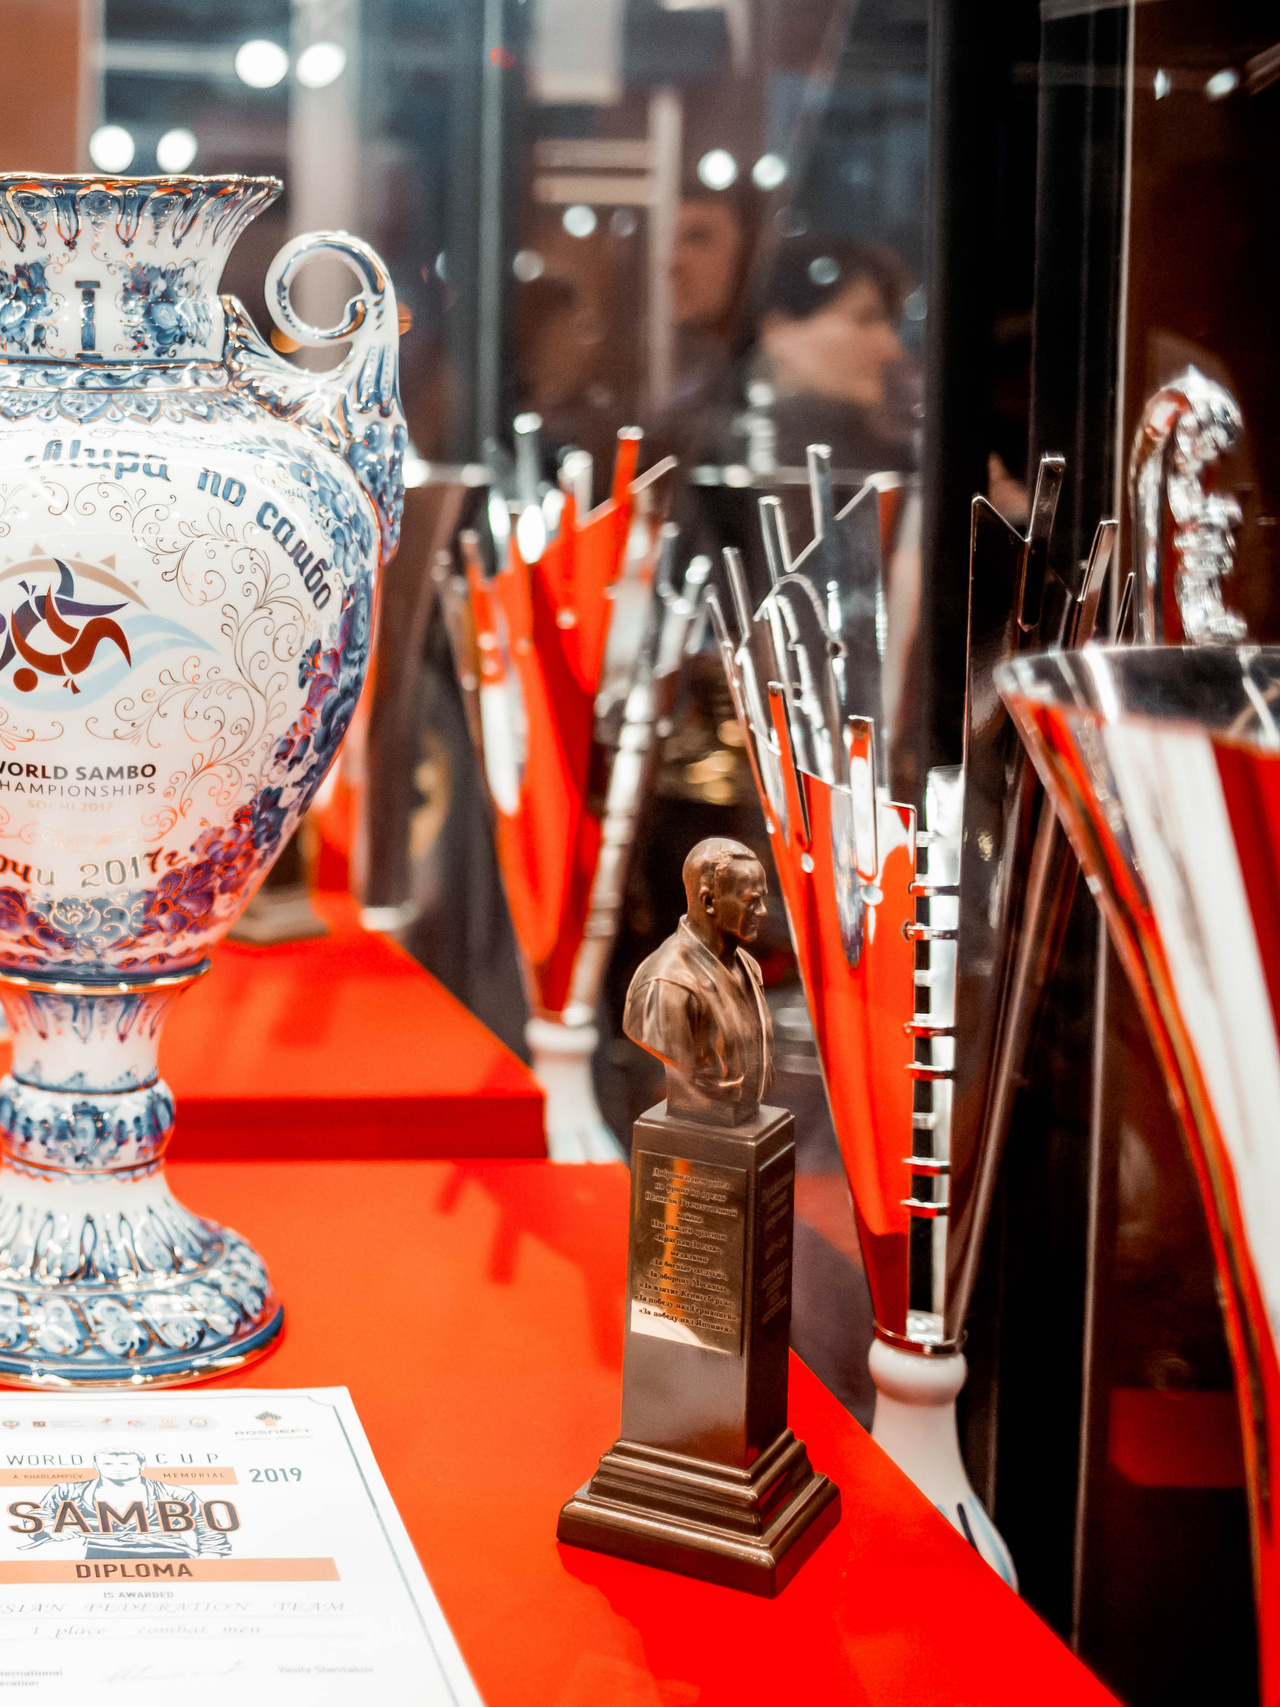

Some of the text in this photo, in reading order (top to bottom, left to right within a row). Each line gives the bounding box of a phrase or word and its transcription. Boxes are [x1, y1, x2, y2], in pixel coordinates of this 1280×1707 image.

[196, 466, 247, 507] по
[255, 500, 333, 611] самбо
[75, 763, 157, 781] SAMBO
[26, 798, 115, 813] SOCHI 2017
[6, 1453, 84, 1467] WORLD
[22, 1472, 84, 1480] KHARLAMPIEV
[162, 1471, 227, 1480] MEMORIAL
[249, 1467, 303, 1483] 2019
[6, 1497, 242, 1536] SAMBO
[75, 1562, 195, 1579] DIPLOMA
[103, 1590, 175, 1599] IS AWARDED
[55, 1623, 106, 1638] place
[223, 1624, 261, 1635] men
